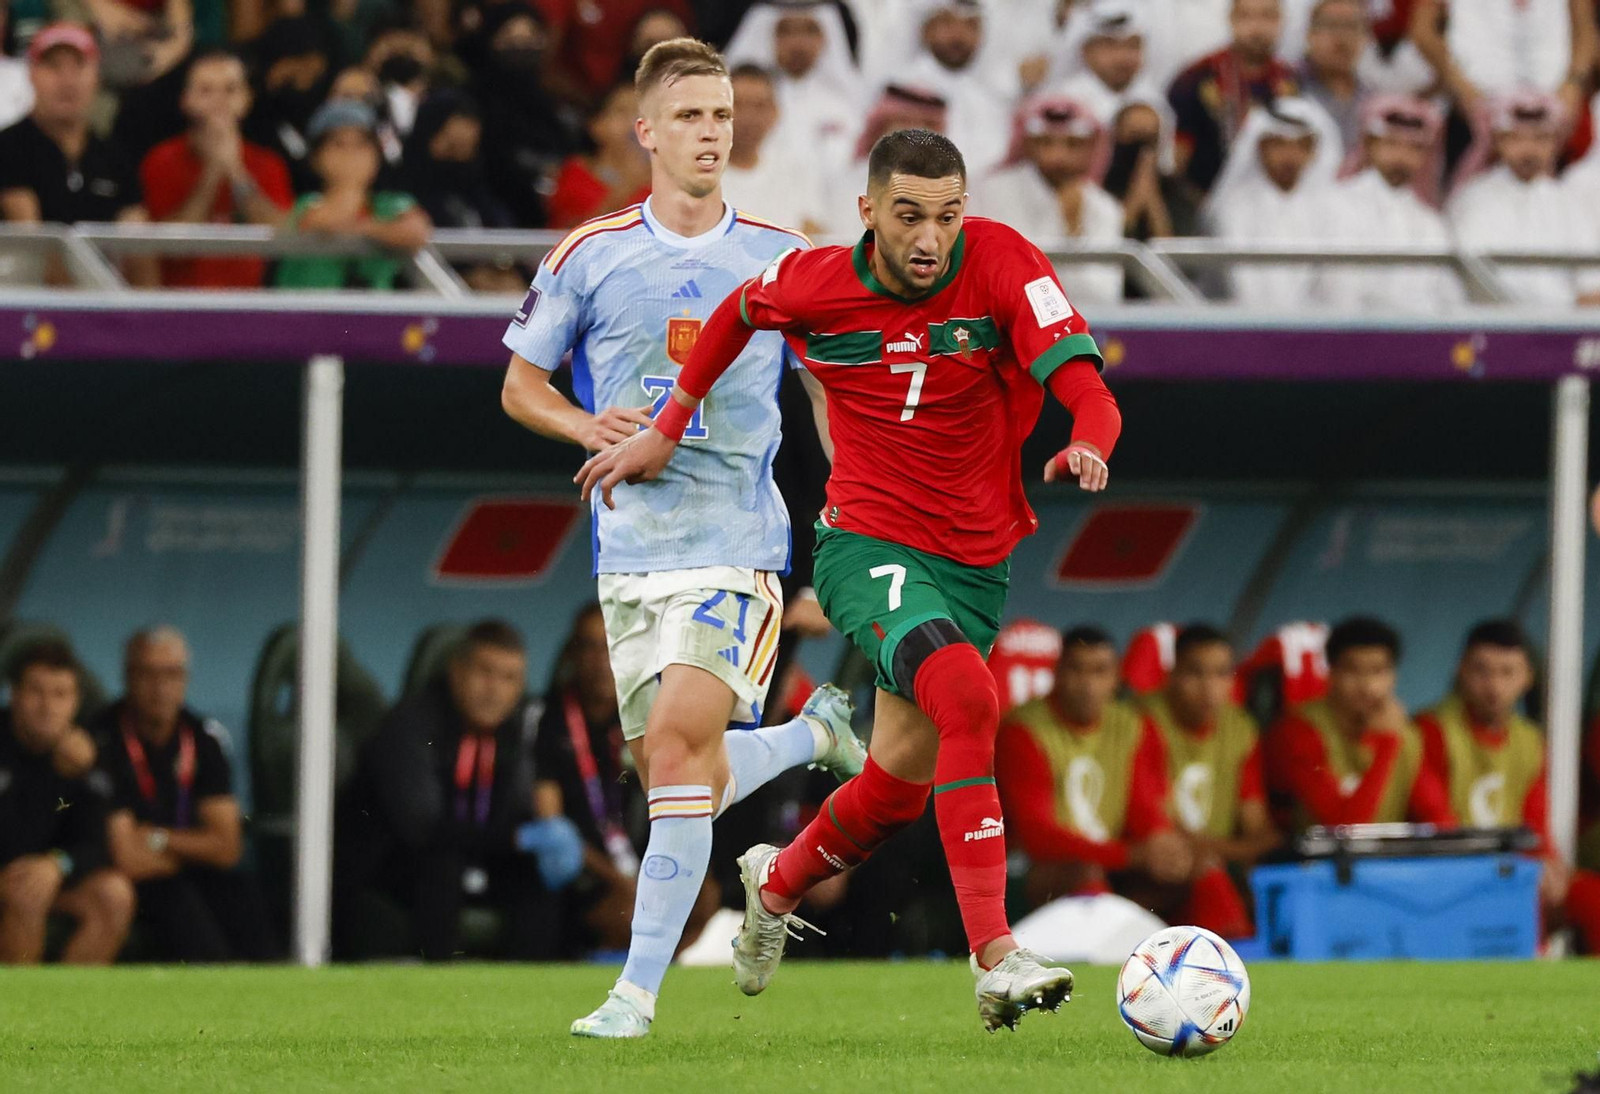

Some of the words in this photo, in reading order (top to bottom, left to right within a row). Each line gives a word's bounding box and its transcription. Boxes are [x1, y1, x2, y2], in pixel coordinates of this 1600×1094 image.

[886, 341, 917, 353] PUMA
[890, 362, 928, 422] 7
[869, 564, 907, 612] 7
[692, 589, 749, 645] 21
